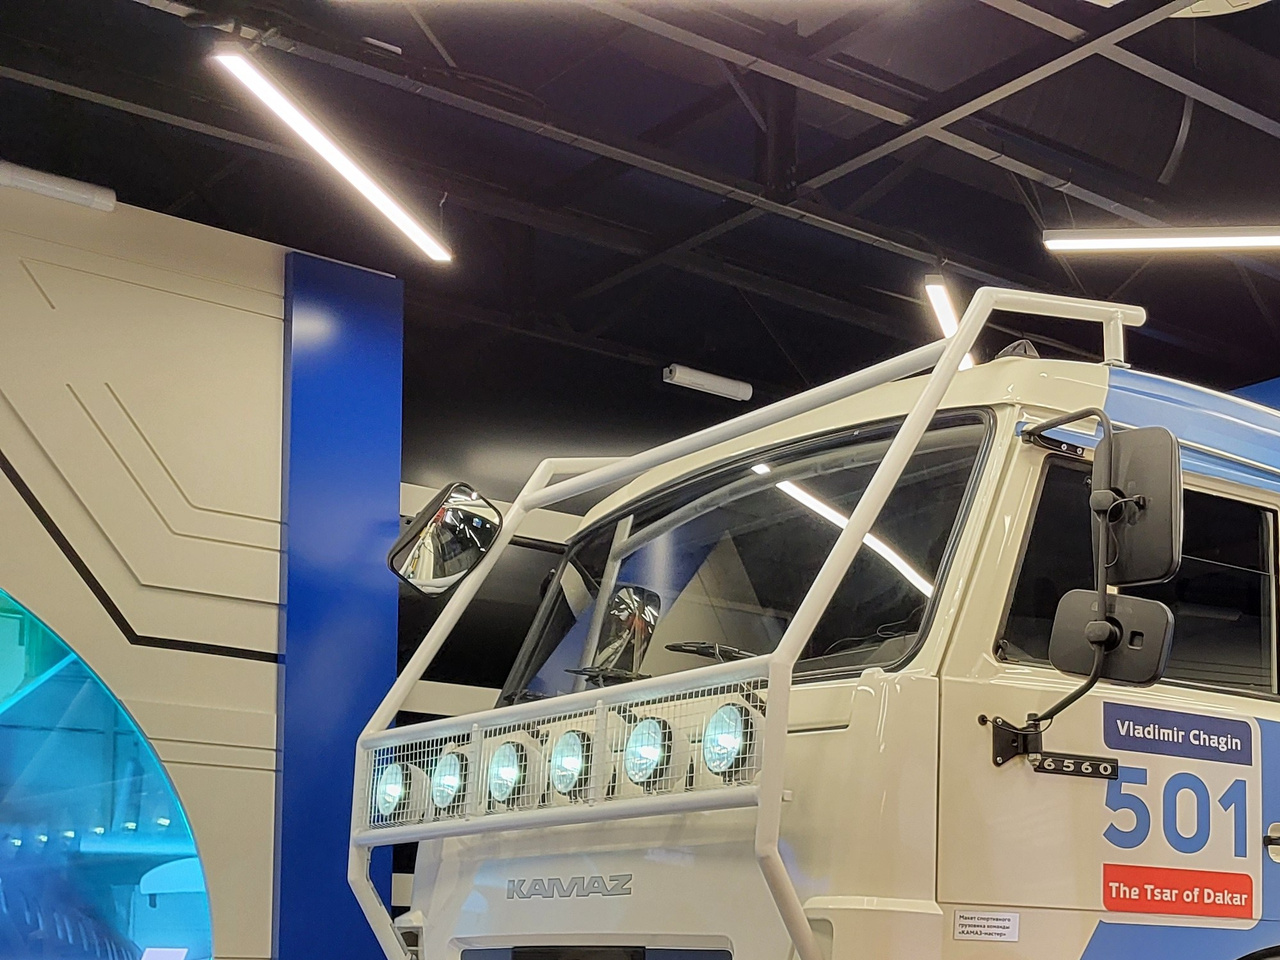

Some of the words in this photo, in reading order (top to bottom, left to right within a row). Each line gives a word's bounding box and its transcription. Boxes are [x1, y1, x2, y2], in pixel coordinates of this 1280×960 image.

[1117, 720, 1185, 745] Vladimir
[1189, 729, 1241, 750] Chagin
[1043, 758, 1113, 776] 6560
[1103, 766, 1248, 858] 501
[507, 874, 633, 899] KAMAZ
[1109, 882, 1140, 900] The
[1144, 884, 1178, 902] Tsar
[1183, 887, 1200, 903] of
[1204, 890, 1248, 907] Dakar
